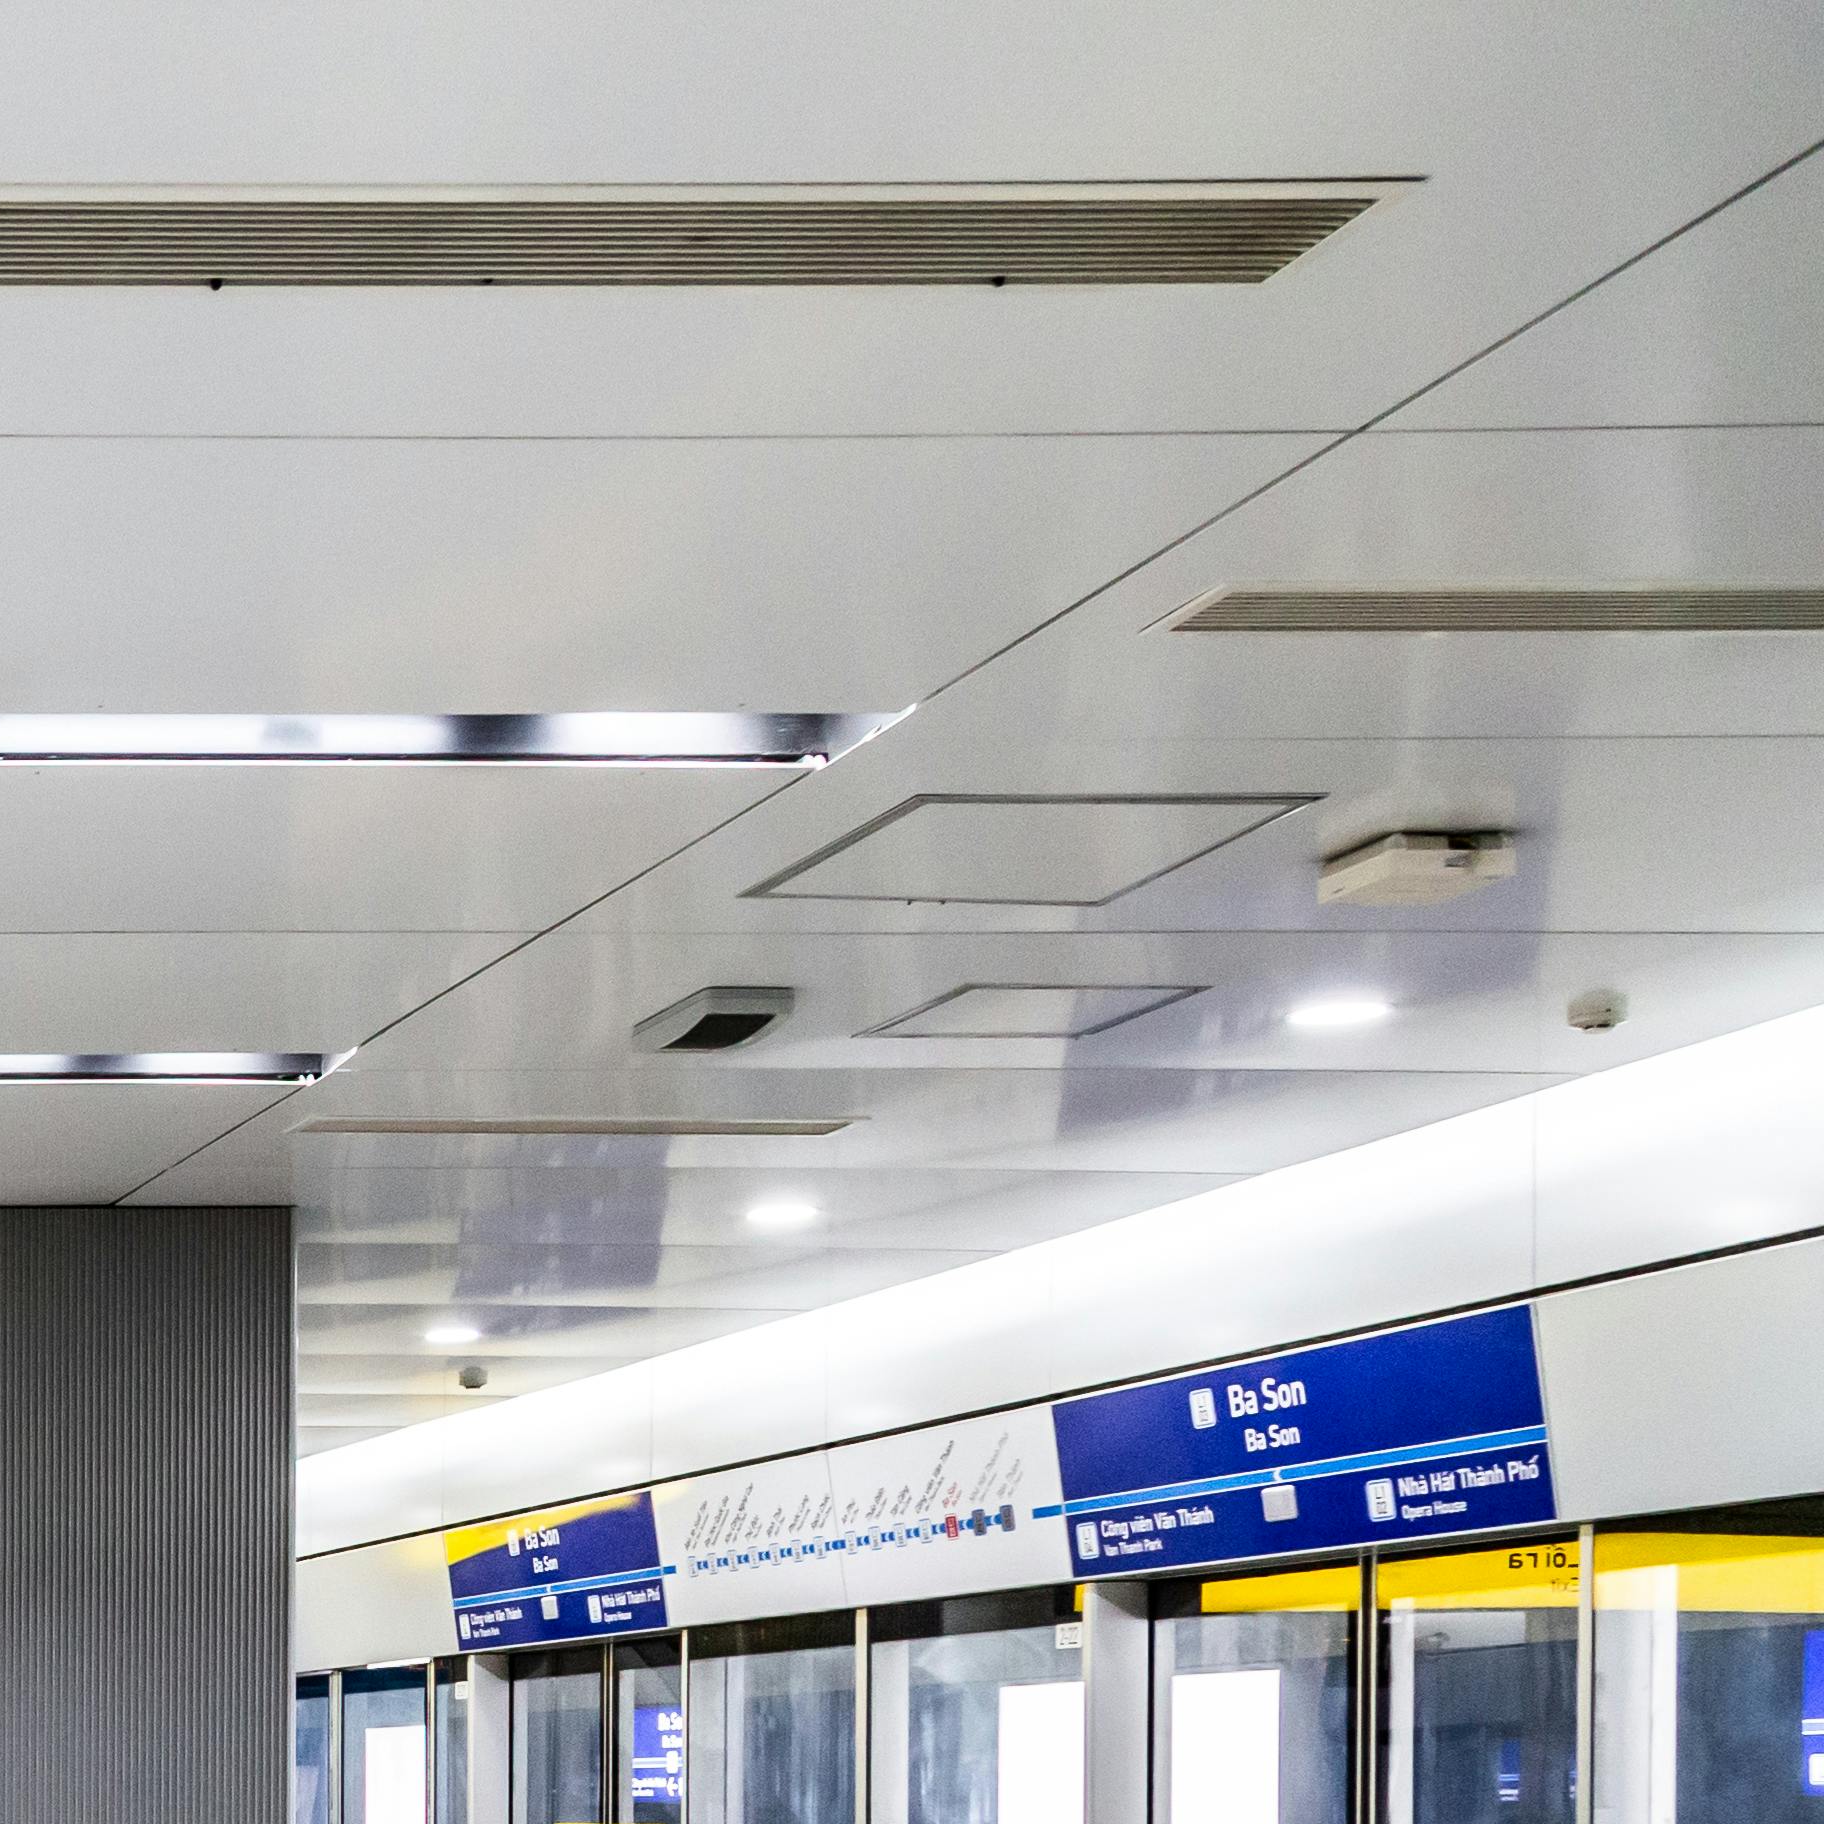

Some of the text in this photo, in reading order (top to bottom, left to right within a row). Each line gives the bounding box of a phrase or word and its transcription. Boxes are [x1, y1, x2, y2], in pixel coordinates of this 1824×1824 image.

[1227, 1377, 1307, 1418] Ba Son
[1244, 1424, 1301, 1452] Ba Son
[1397, 1454, 1540, 1498] Nhà Hát Thành Phố
[1100, 1520, 1129, 1540] Công
[1176, 1505, 1215, 1527] Thánh
[1401, 1500, 1468, 1522] Opera House
[524, 1524, 560, 1550] Ba Son
[532, 1555, 559, 1574] Ba Son
